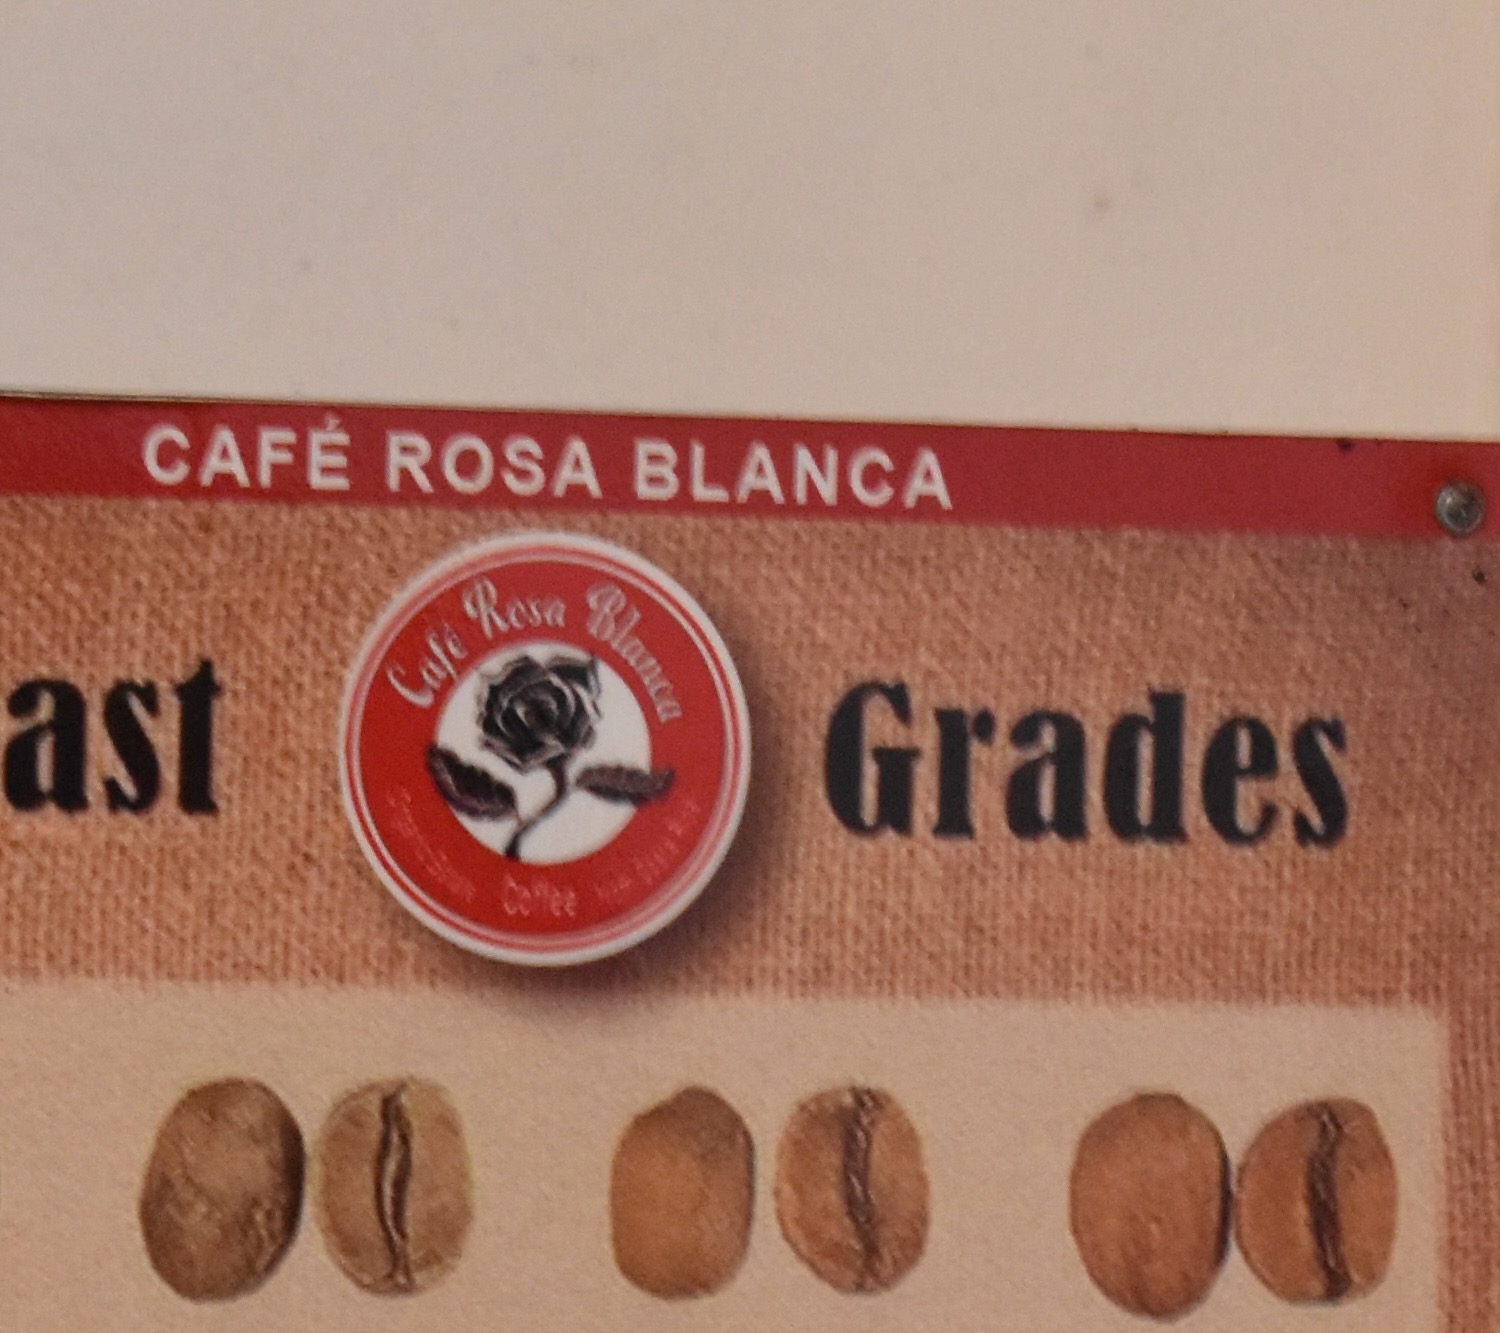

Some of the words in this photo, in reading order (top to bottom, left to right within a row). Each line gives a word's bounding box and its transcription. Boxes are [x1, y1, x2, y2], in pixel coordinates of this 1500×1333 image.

[142, 416, 350, 489] CAFÉ
[386, 432, 602, 498] ROSA
[634, 440, 953, 510] BLANCA
[387, 621, 468, 709] Café
[462, 575, 568, 641] Rosa
[586, 580, 683, 725] Blanca
[823, 680, 1349, 849] Grades
